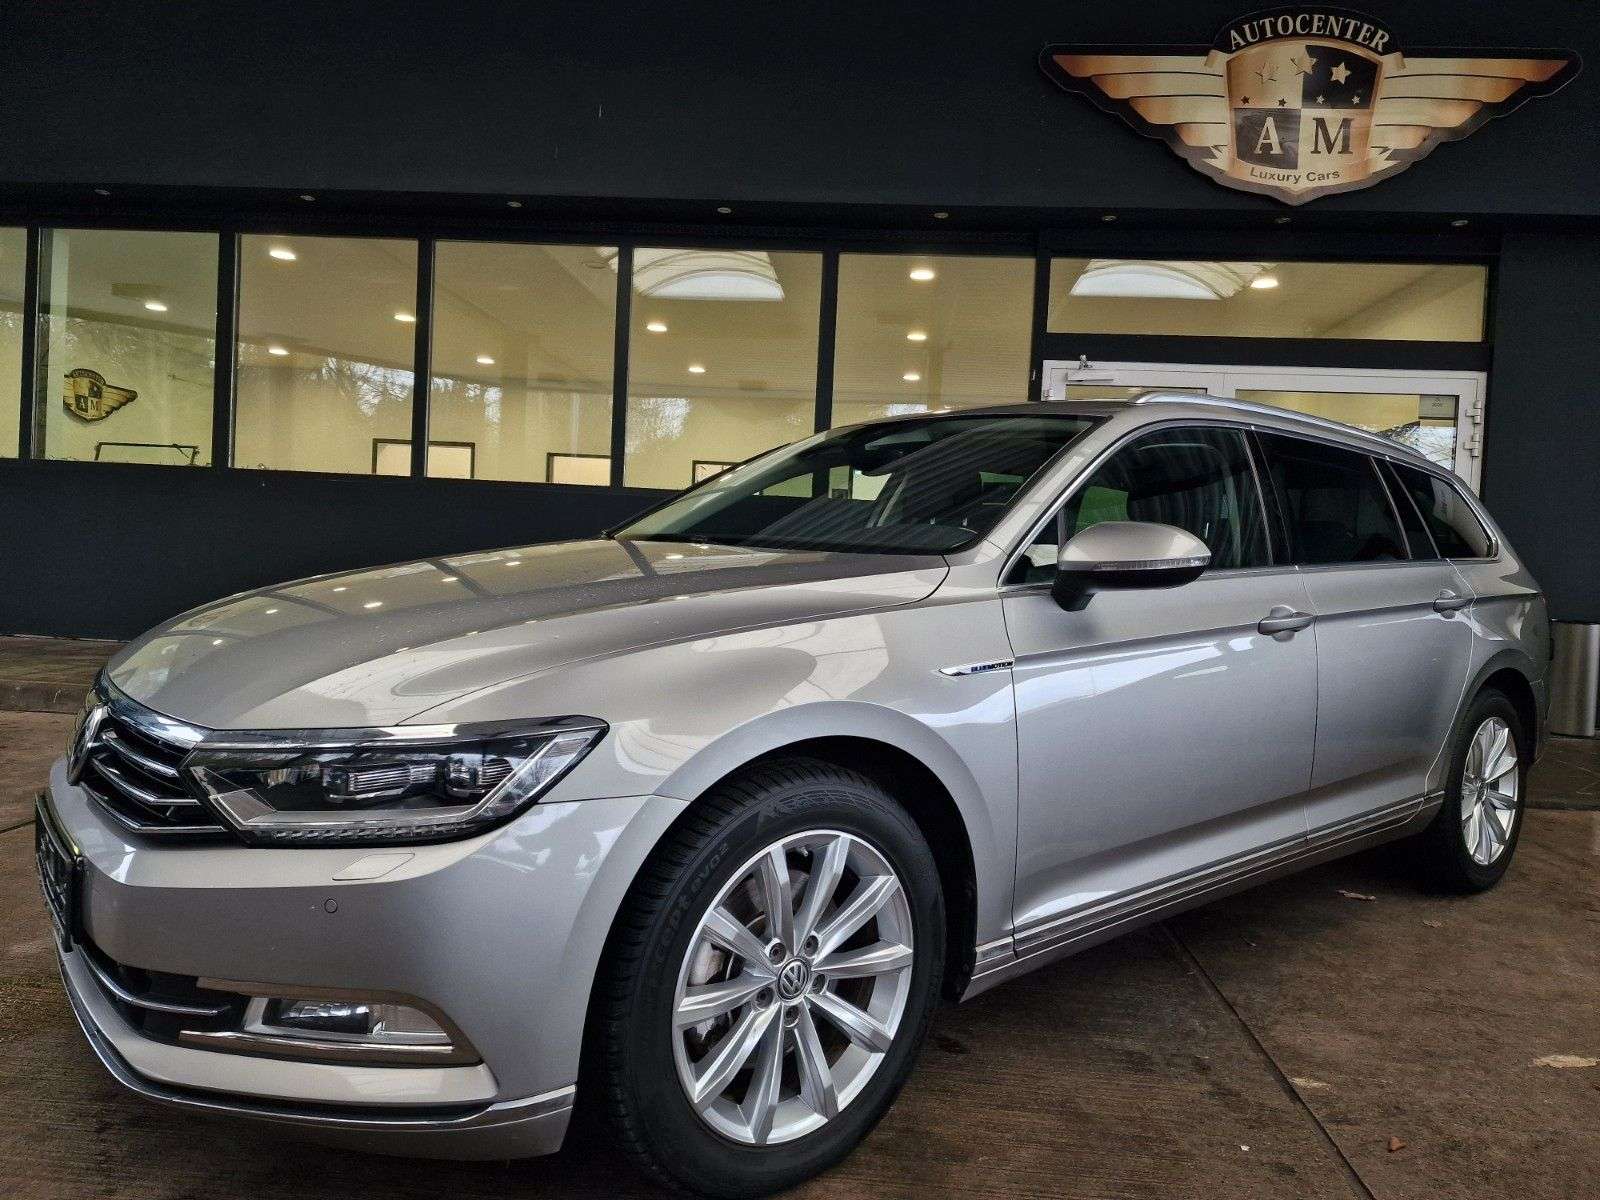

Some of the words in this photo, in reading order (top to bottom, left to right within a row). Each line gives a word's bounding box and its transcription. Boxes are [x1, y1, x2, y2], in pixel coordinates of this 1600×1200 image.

[1229, 14, 1390, 51] AUTOCENTER
[1254, 116, 1284, 155] A
[1310, 117, 1354, 155] M
[1250, 167, 1301, 184] Luxury
[1306, 169, 1340, 182] Cars
